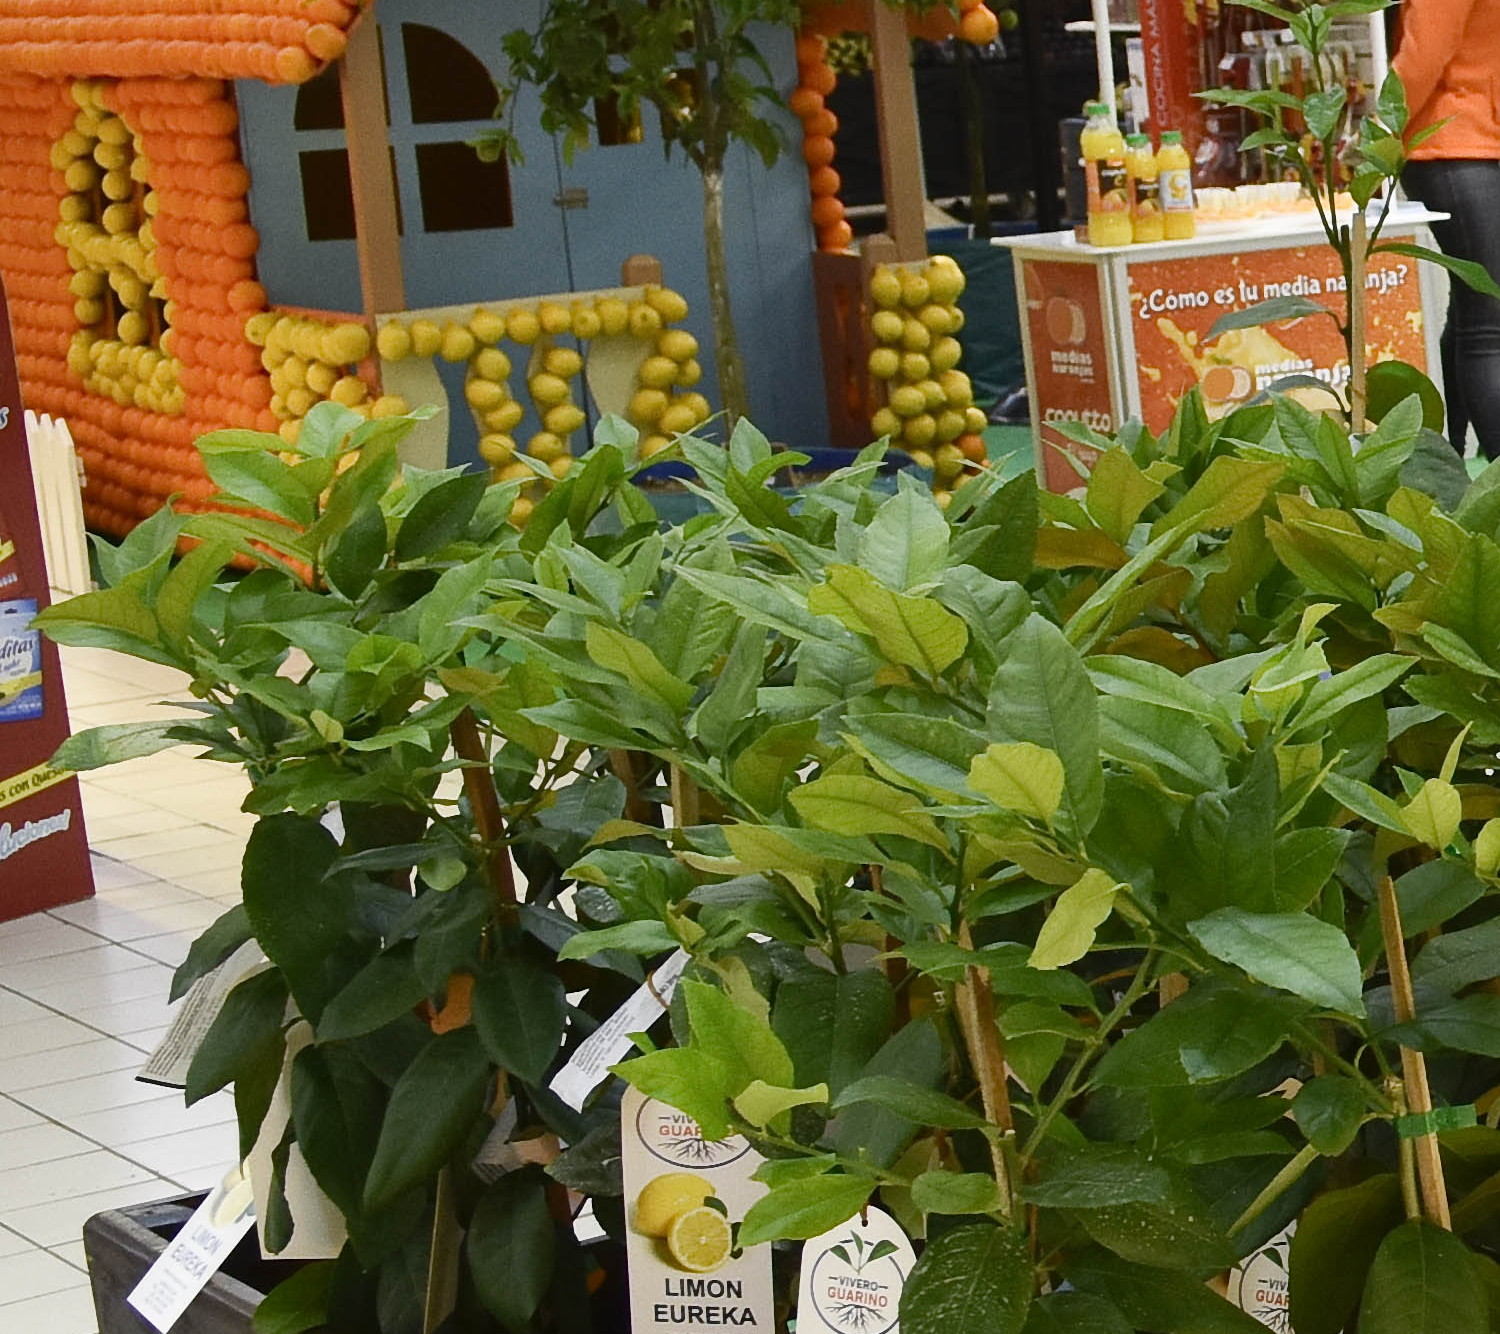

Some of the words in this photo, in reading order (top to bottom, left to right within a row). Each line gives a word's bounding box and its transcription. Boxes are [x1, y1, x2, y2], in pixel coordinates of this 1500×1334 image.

[1139, 283, 1209, 320] ¿Cómo
[1215, 285, 1236, 305] es
[1240, 278, 1260, 302] tu
[1264, 273, 1321, 299] media
[9, 773, 30, 795] con
[665, 1278, 742, 1299] LIMON
[839, 1275, 879, 1292] VIVERO
[827, 1286, 888, 1308] GUARINO
[654, 1304, 757, 1326] EUREKA
